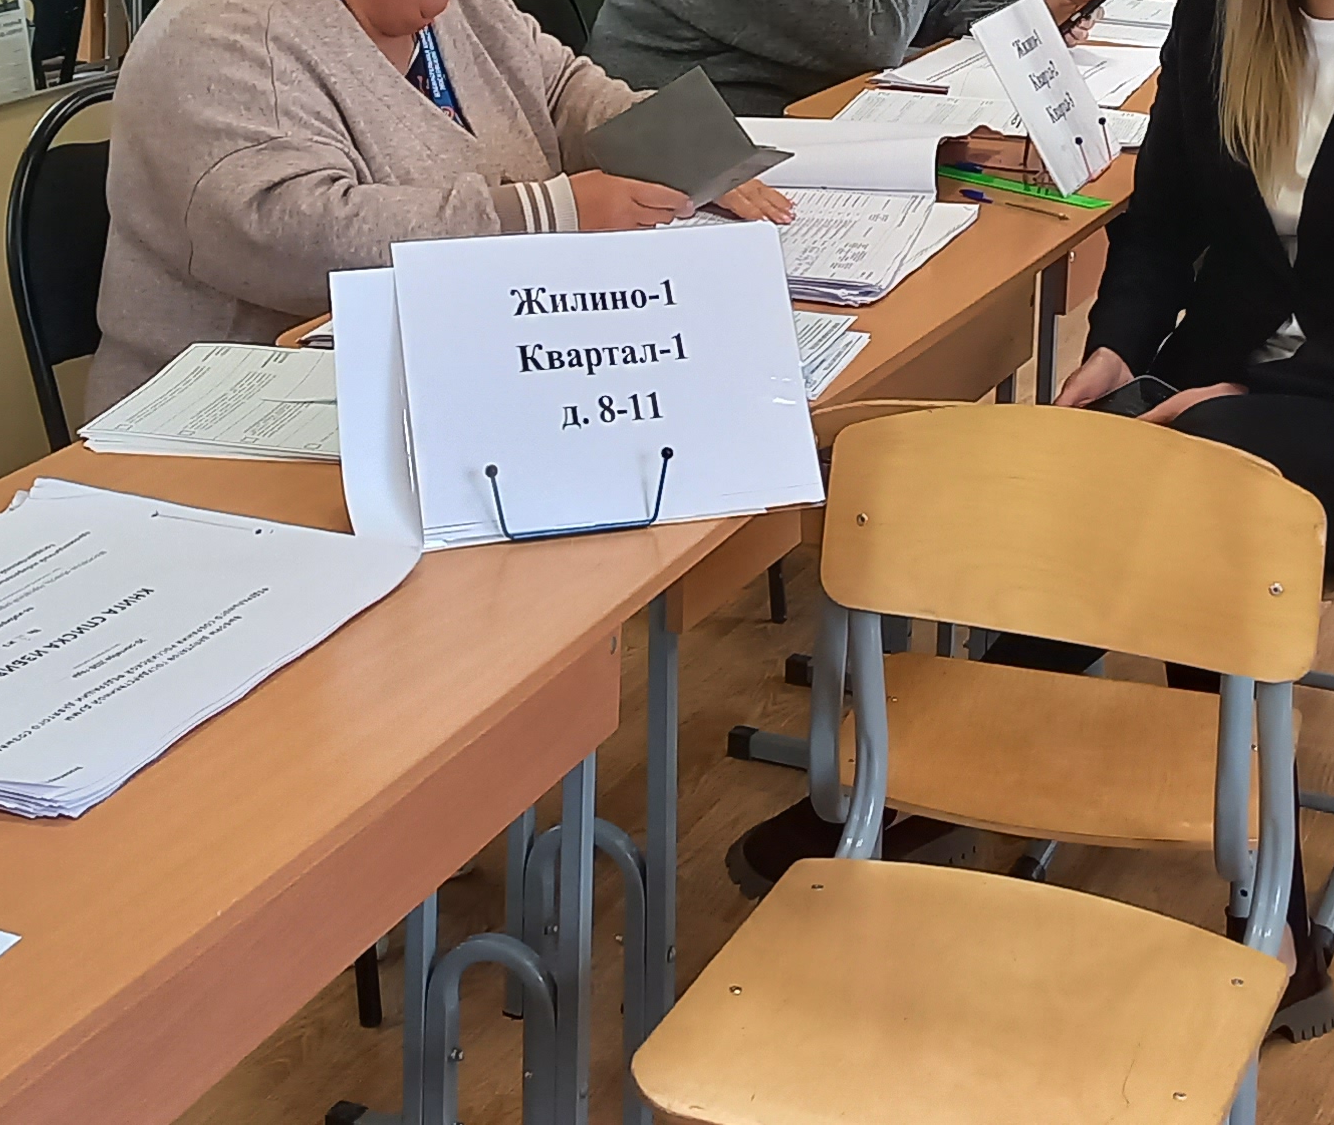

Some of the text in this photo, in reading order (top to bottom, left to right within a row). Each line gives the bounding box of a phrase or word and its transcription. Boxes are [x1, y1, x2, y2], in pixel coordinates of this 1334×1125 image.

[511, 280, 675, 315] Жилино-1
[517, 333, 686, 375] Квартал-1
[563, 392, 661, 429] д. 8-11
[99, 587, 156, 616] КНИГА
[41, 614, 110, 650] СПИСКА
